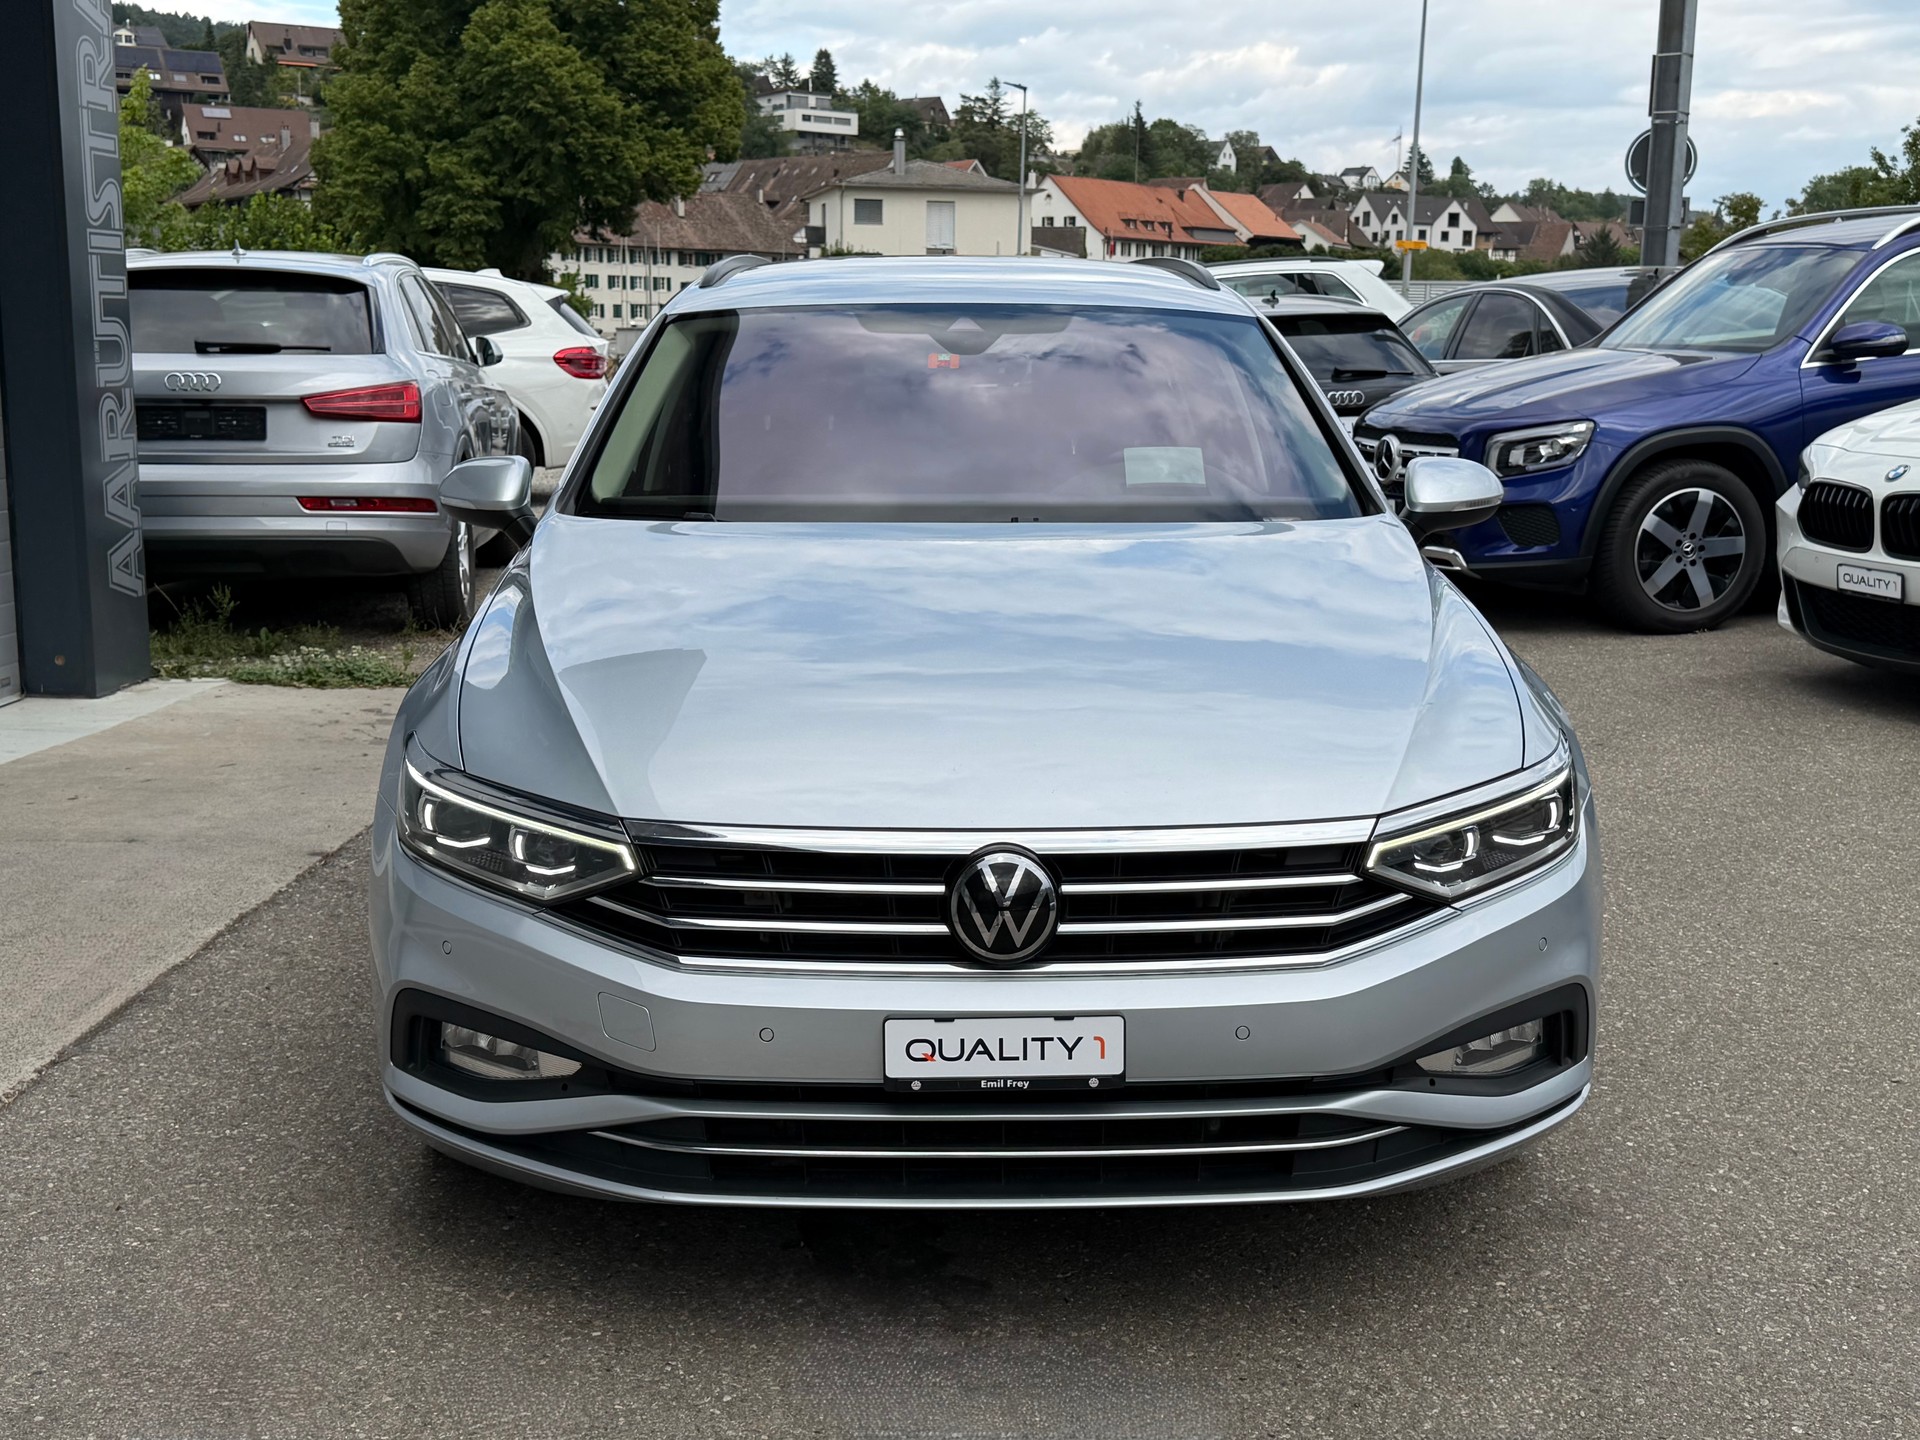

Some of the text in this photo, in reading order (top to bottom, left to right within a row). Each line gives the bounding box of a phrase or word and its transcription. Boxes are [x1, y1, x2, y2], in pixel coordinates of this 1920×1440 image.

[1843, 572, 1890, 590] QUALITY
[905, 1036, 1106, 1062] QUALITY 1
[981, 1079, 1030, 1090] Emil Frey
